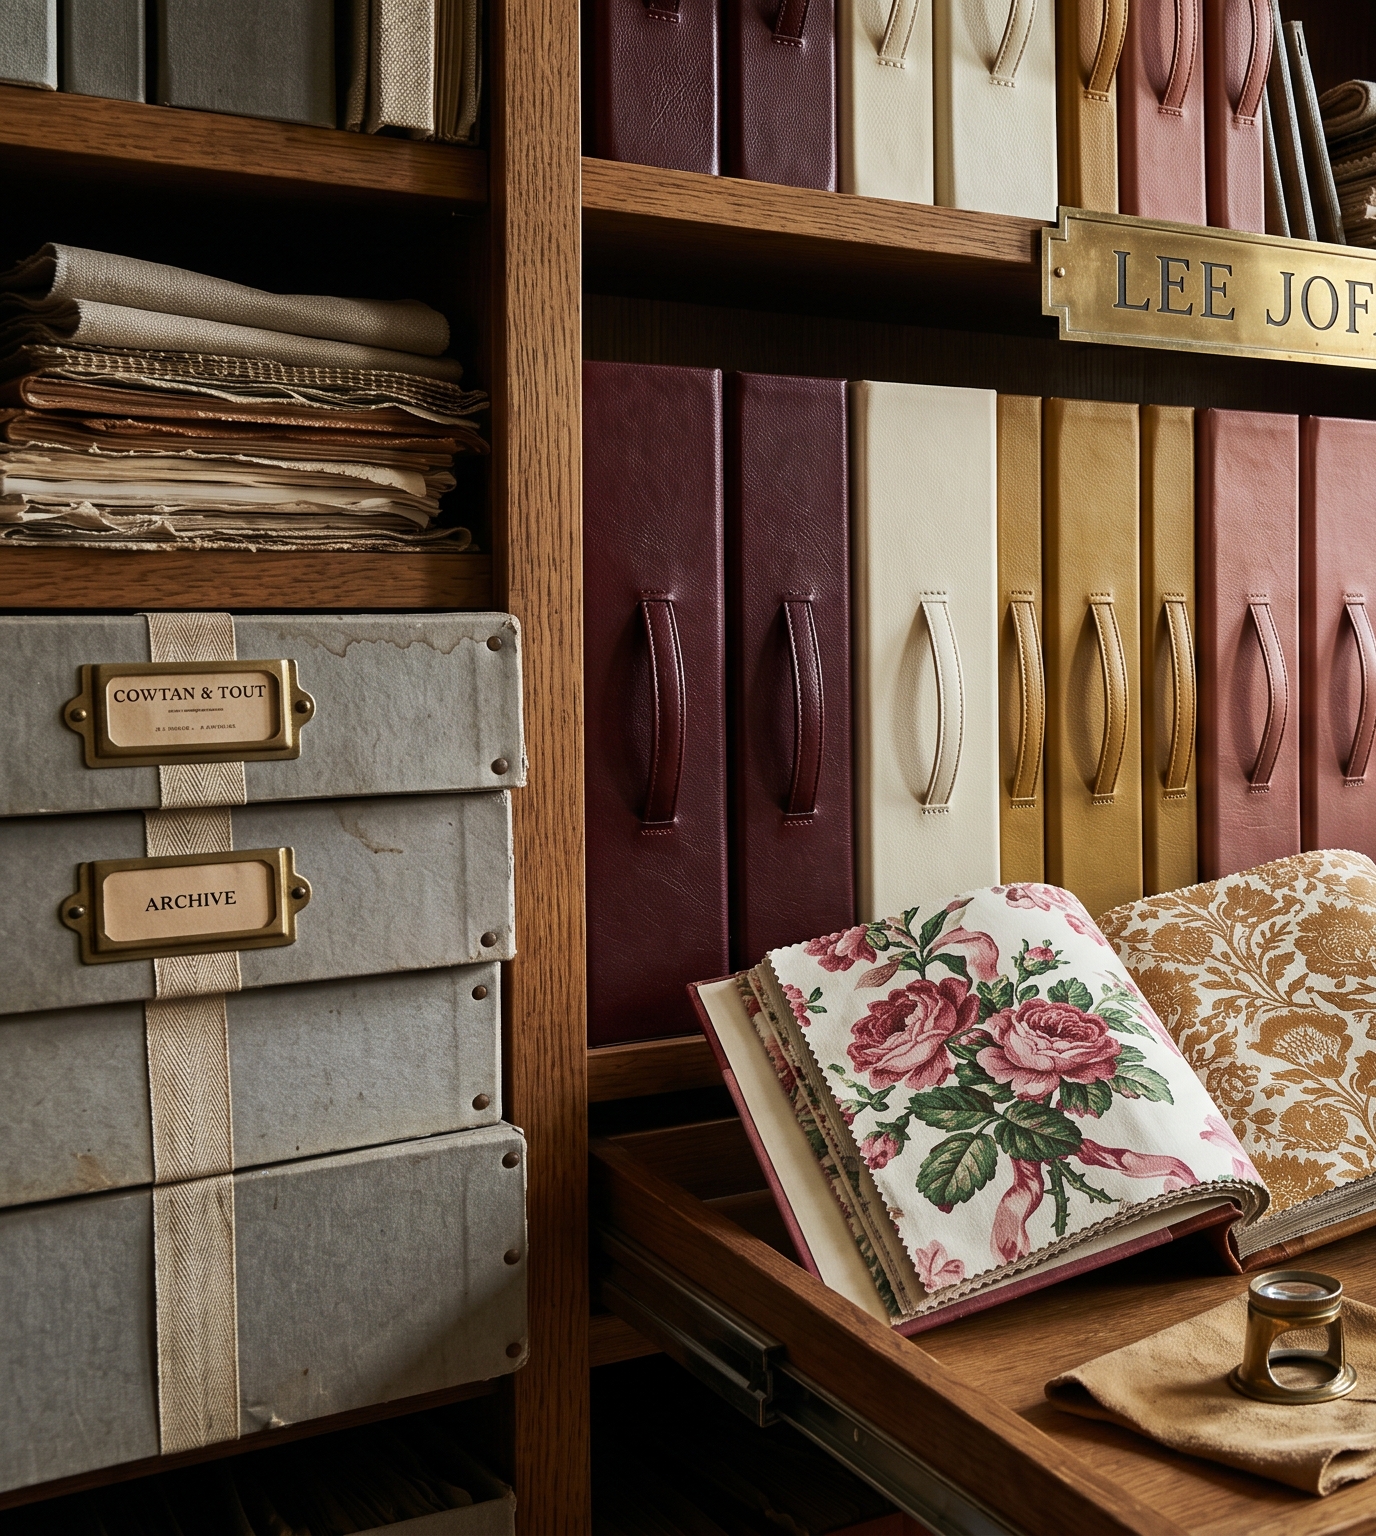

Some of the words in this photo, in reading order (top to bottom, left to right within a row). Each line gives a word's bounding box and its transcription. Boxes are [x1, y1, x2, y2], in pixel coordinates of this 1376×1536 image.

[1112, 250, 1236, 321] LEE
[113, 687, 195, 703] COWTAN
[200, 686, 213, 700] &
[217, 684, 267, 699] TOUT
[145, 890, 237, 912] ARCHIVE
